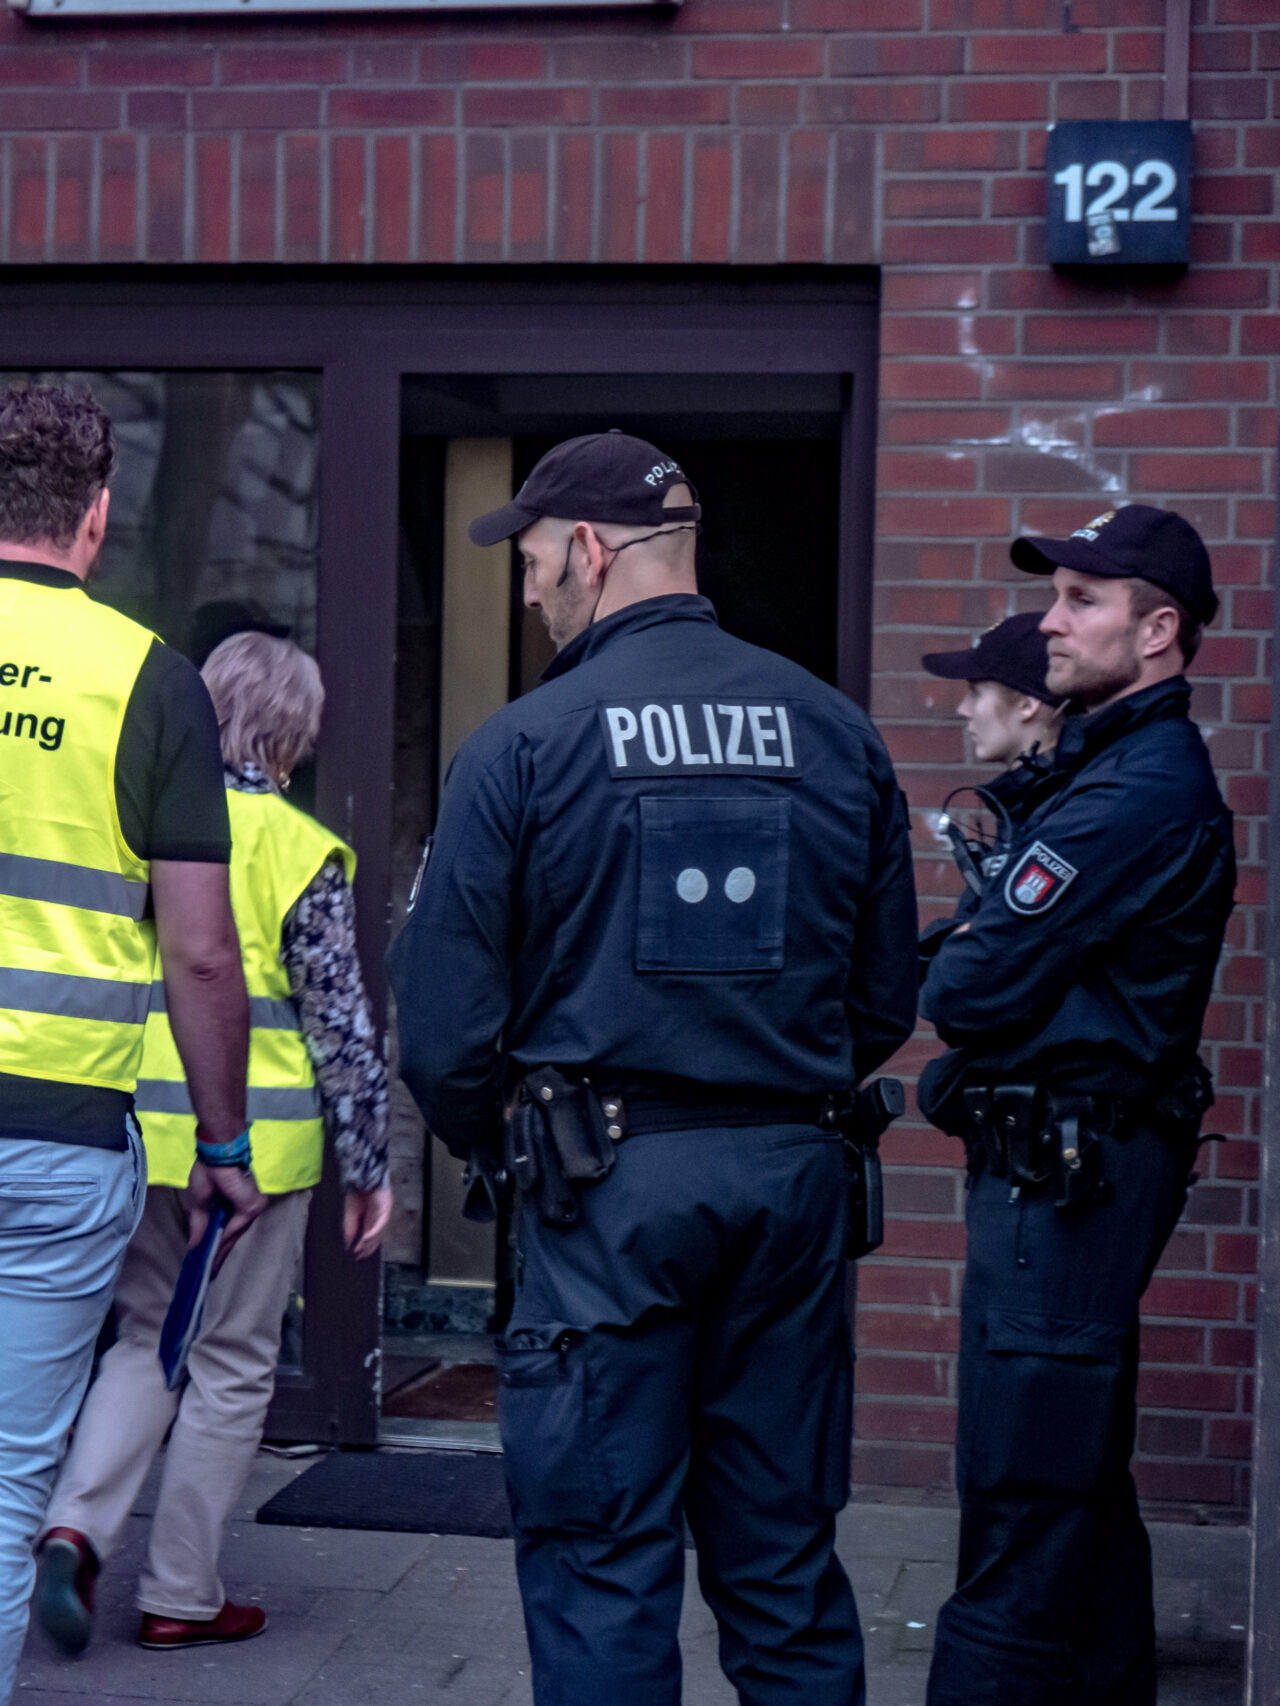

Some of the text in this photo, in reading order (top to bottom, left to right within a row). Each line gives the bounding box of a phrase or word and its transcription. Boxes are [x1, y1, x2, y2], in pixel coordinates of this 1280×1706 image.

[1054, 159, 1178, 222] 122
[605, 703, 795, 767] POLIZEI
[1030, 847, 1073, 880] POLIZEI
